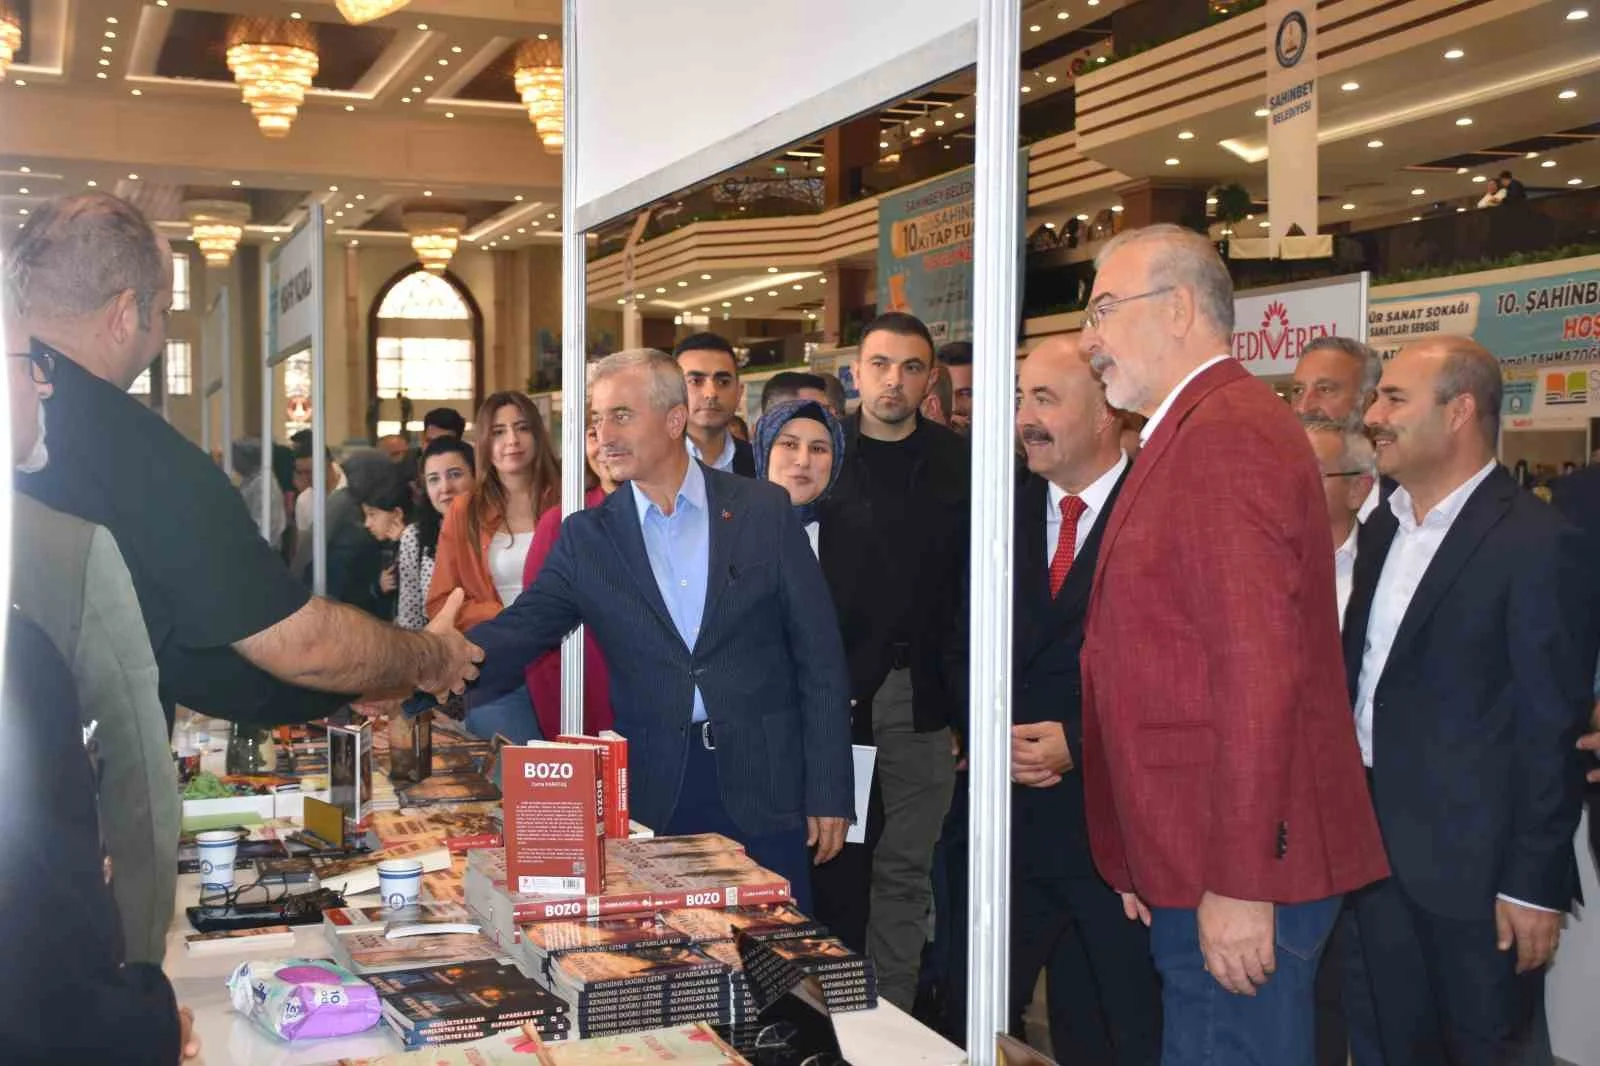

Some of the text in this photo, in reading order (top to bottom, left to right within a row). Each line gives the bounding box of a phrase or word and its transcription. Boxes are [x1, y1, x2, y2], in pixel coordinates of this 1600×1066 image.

[1497, 280, 1600, 314] 10. ŞAHİNB
[1386, 308, 1424, 322] SANAT
[1426, 301, 1470, 318] SOKAĞI
[524, 762, 573, 779] BOZO
[686, 892, 720, 906] BOZO
[545, 902, 581, 917] BOZO
